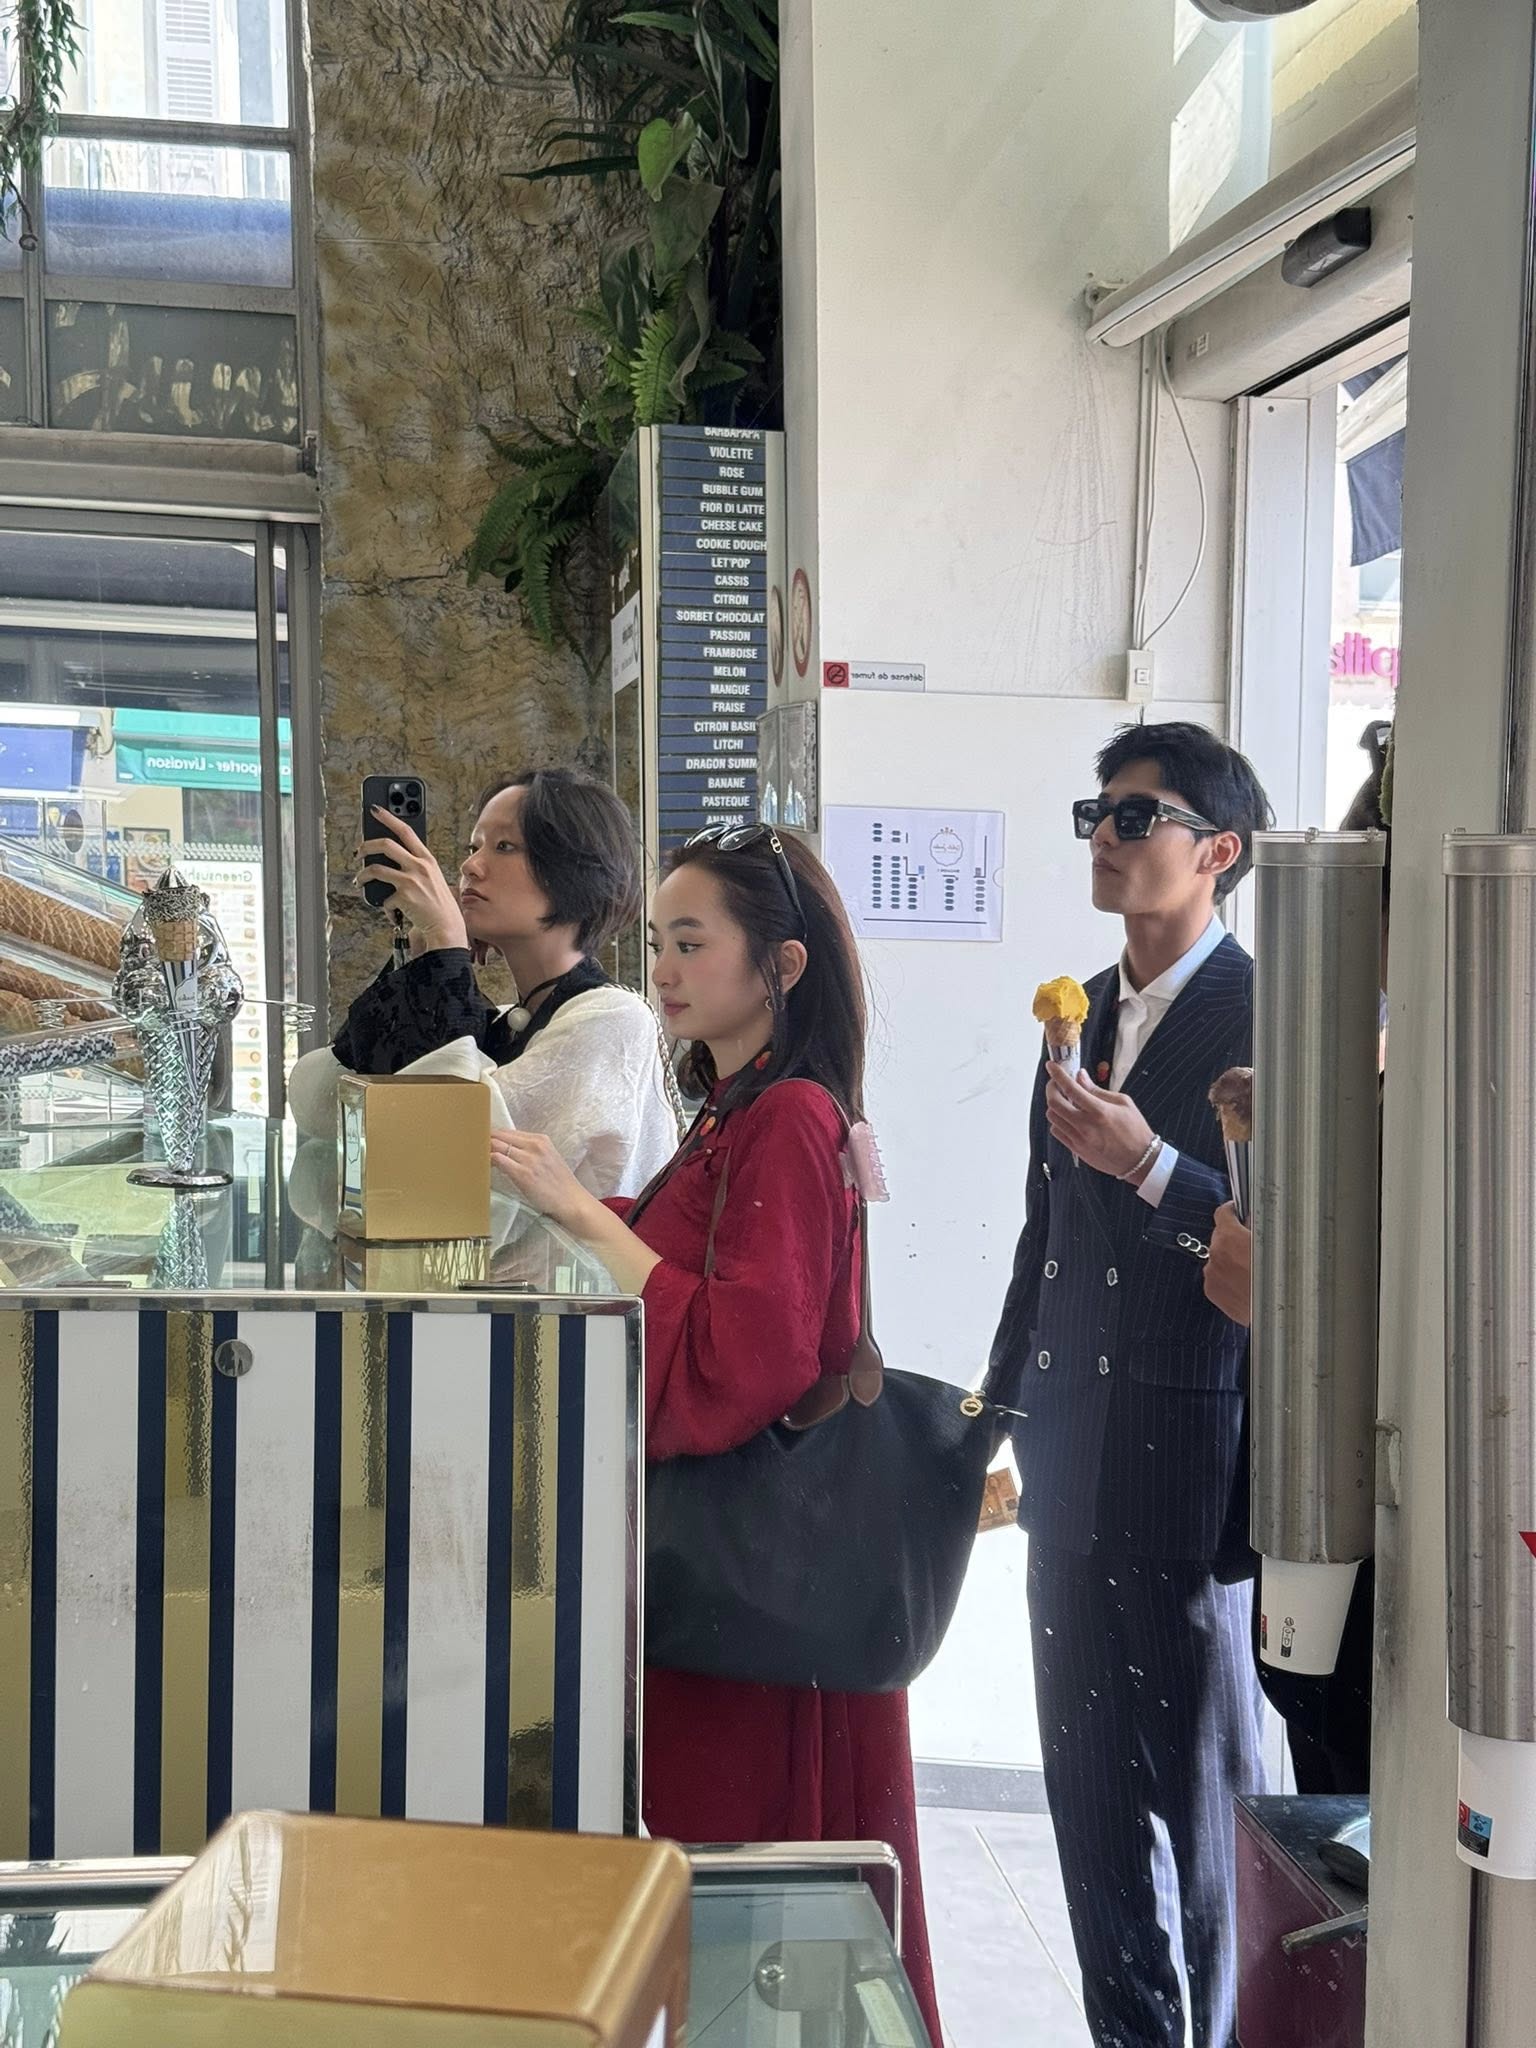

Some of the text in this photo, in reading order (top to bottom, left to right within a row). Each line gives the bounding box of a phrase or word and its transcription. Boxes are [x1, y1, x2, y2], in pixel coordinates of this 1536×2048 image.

[708, 446, 754, 460] VIOLETTE
[719, 465, 745, 479] ROSE
[702, 483, 763, 497] BUBBLE GUM
[700, 501, 765, 515] FIOR DI LATTE
[701, 519, 763, 532] CHEESE CAKE
[695, 537, 768, 552] COOKIE DOUGH
[714, 574, 750, 587] CASSIS
[713, 593, 749, 606] CITRON
[675, 610, 765, 624] SORBET CHOCOLAT
[709, 629, 751, 642] PASSION
[703, 646, 758, 659] FRAMBOISE
[713, 665, 747, 678] MELON
[710, 683, 751, 696] MANGUE
[712, 701, 746, 714] FRAISE
[693, 720, 729, 733] CITRON
[713, 738, 744, 751] LITCHI
[685, 757, 726, 770] DRAGON
[707, 777, 746, 790] BANANE
[702, 796, 751, 808] PASTEQUE
[706, 815, 745, 826] ANANAS
